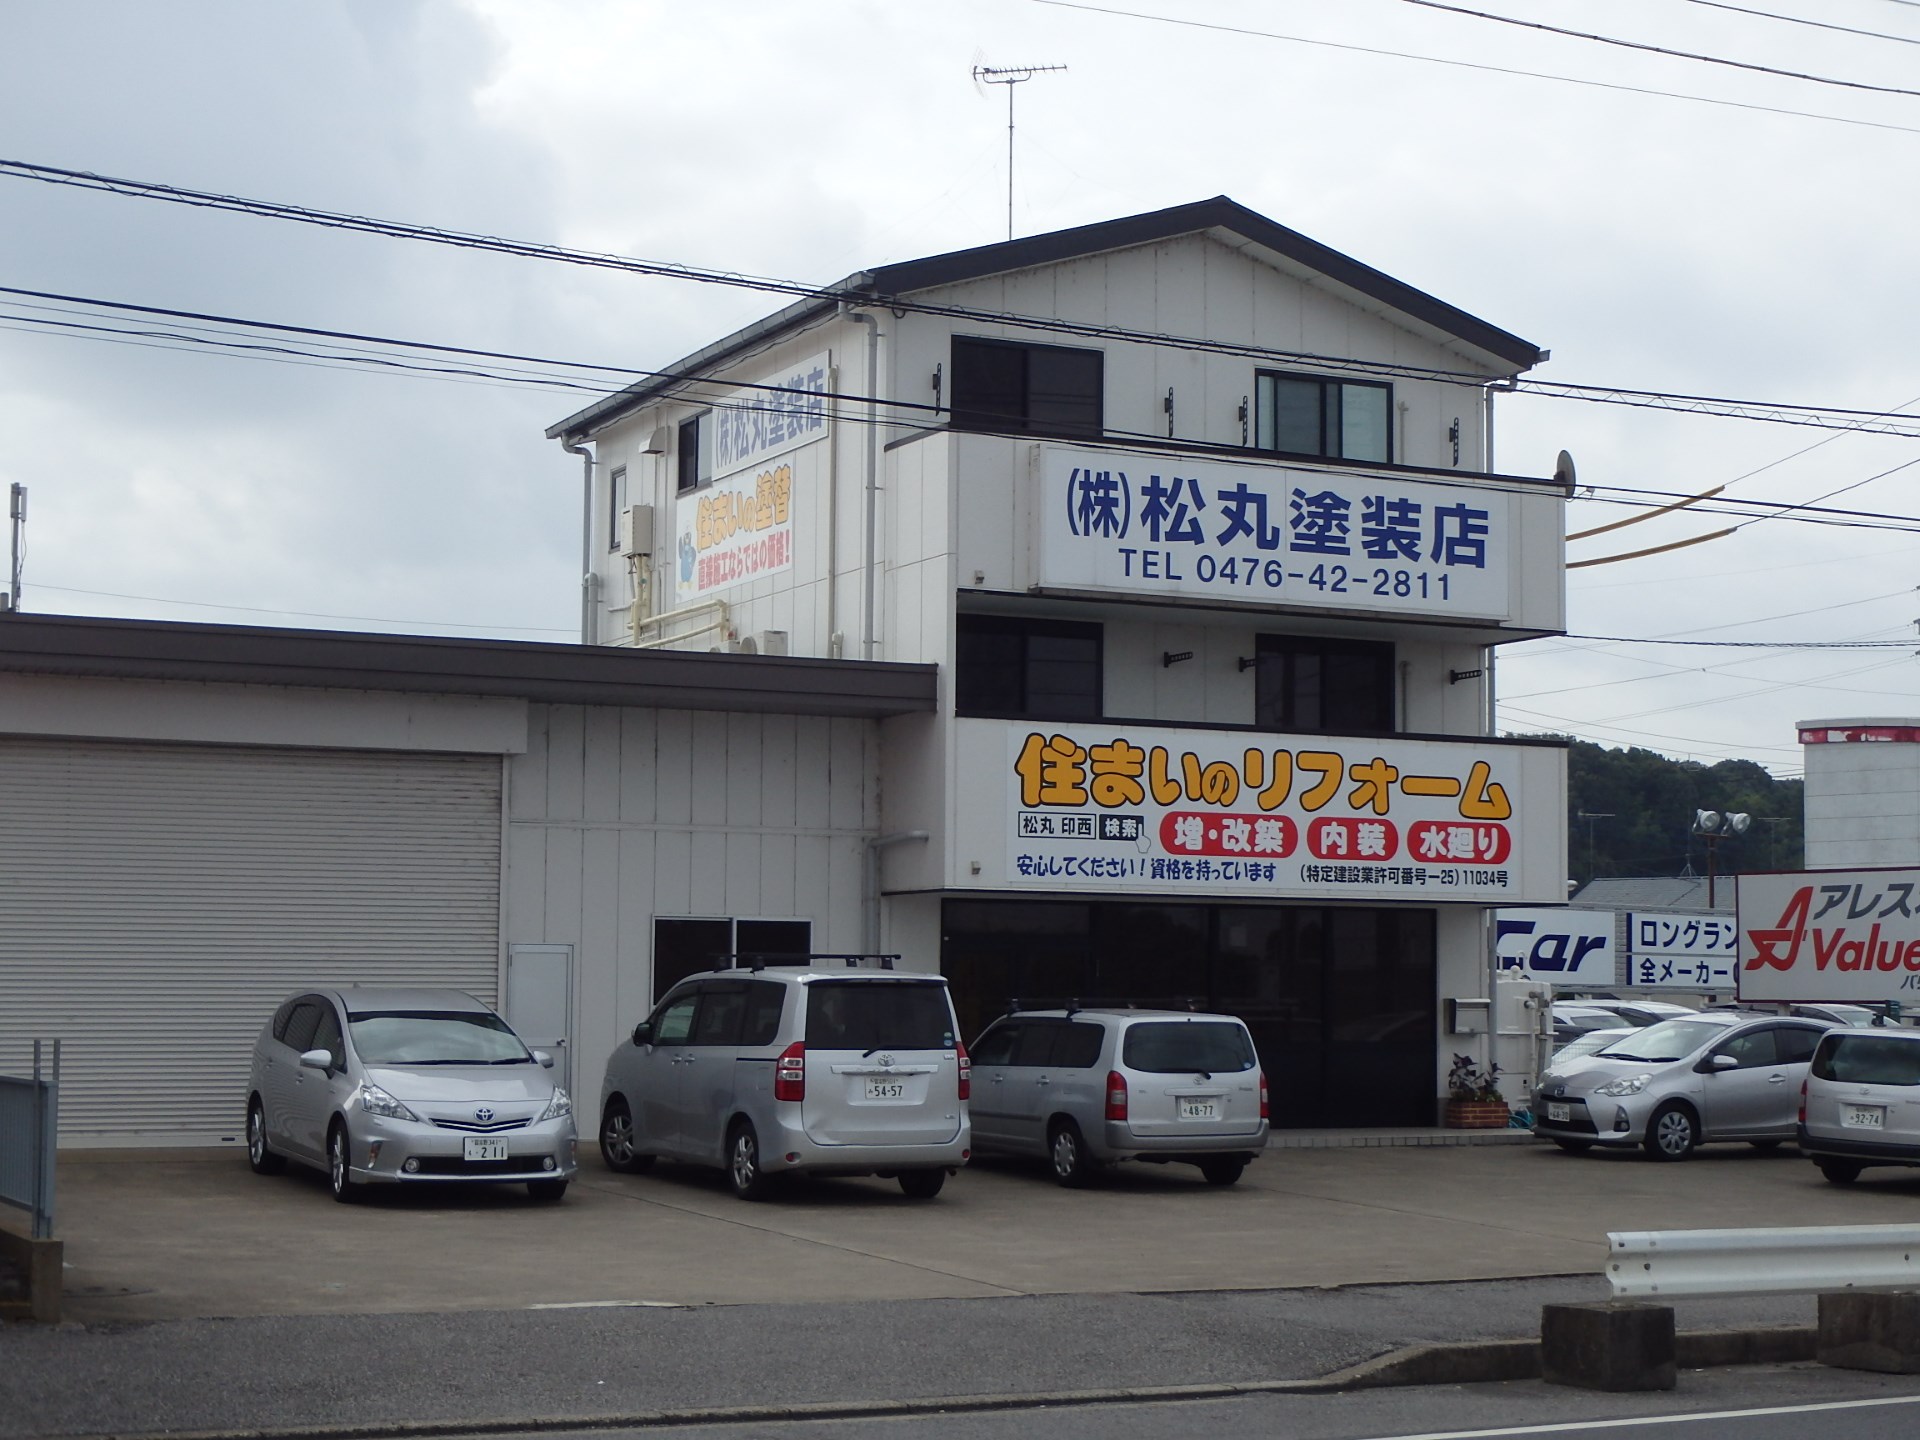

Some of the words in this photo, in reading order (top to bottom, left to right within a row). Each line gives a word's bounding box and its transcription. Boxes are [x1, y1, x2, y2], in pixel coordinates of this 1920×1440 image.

[1066, 467, 1489, 569] (株)松丸塗装店
[1118, 548, 1182, 581] TEL
[1196, 555, 1450, 600] 0476-42-2811
[1014, 732, 1512, 820] 住まいのリフォーム
[1023, 815, 1055, 835] 松丸
[1061, 816, 1093, 836] 印西
[1104, 817, 1137, 838] 検索
[1174, 816, 1284, 854] 増・改築
[1320, 821, 1386, 857] 内装
[1419, 825, 1499, 861] 水廻り
[1813, 883, 1920, 921] アレス
[1640, 920, 1738, 950] ロングラン
[1639, 957, 1738, 985] 全メーカー
[874, 1085, 903, 1097] 54-57
[1188, 1105, 1213, 1116] 48-77
[1855, 1113, 1879, 1125] 92-74
